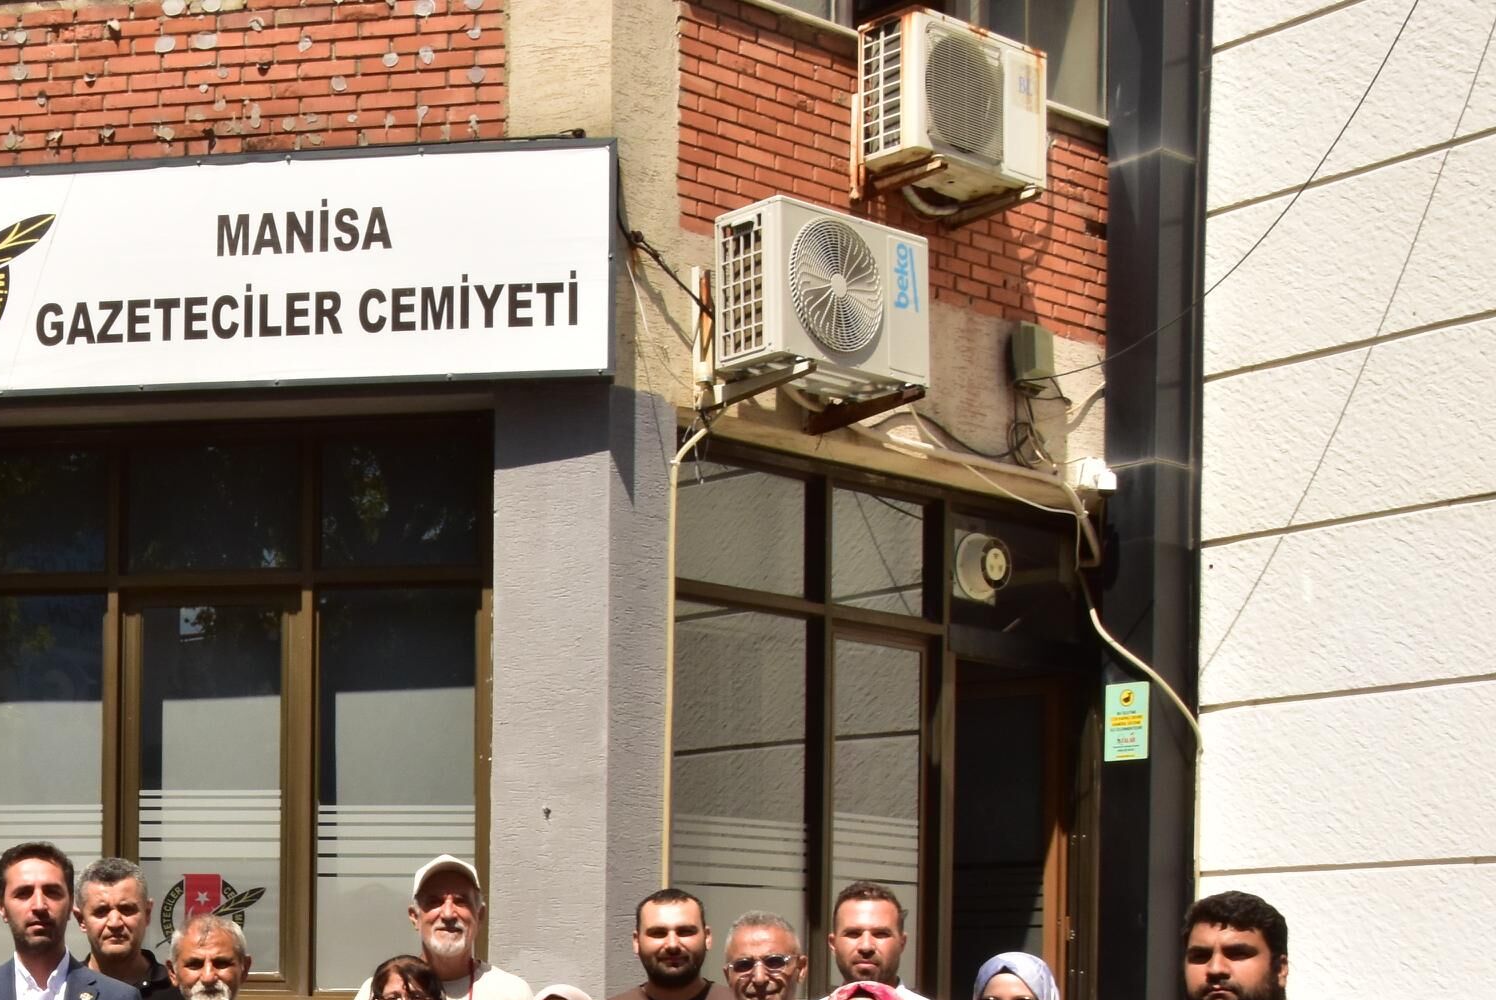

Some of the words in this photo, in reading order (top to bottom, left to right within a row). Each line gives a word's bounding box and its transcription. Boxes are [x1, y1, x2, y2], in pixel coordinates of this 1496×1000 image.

[216, 198, 393, 257] MANİSA
[35, 283, 343, 347] GAZETECİLER
[358, 269, 579, 334] CEMİYETİ
[894, 243, 909, 309] beko
